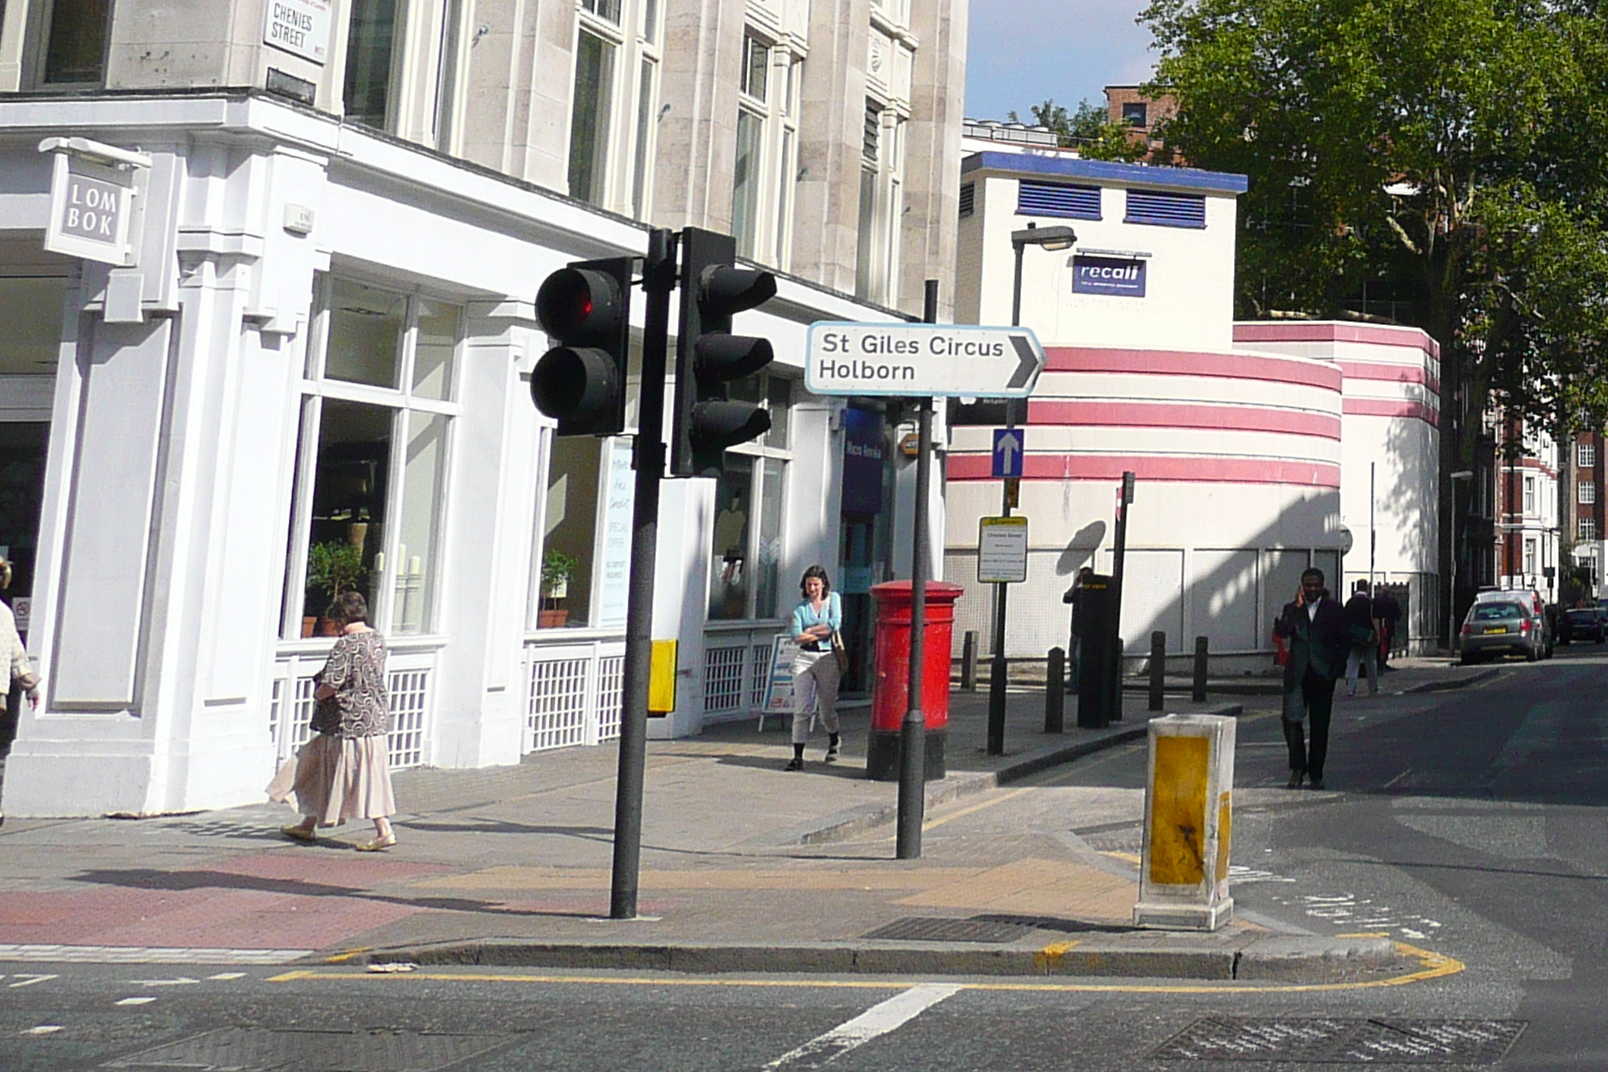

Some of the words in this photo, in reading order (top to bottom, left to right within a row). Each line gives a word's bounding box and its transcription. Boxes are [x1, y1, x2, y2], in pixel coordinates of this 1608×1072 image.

[273, 2, 313, 32] CHENIES
[271, 21, 306, 49] STREET
[72, 184, 116, 214] LOM
[67, 207, 113, 236] BOK
[1081, 265, 1139, 280] recall
[822, 333, 849, 353] St
[861, 334, 920, 355] Giles
[929, 336, 1004, 357] Circus
[819, 359, 915, 380] Holborn
